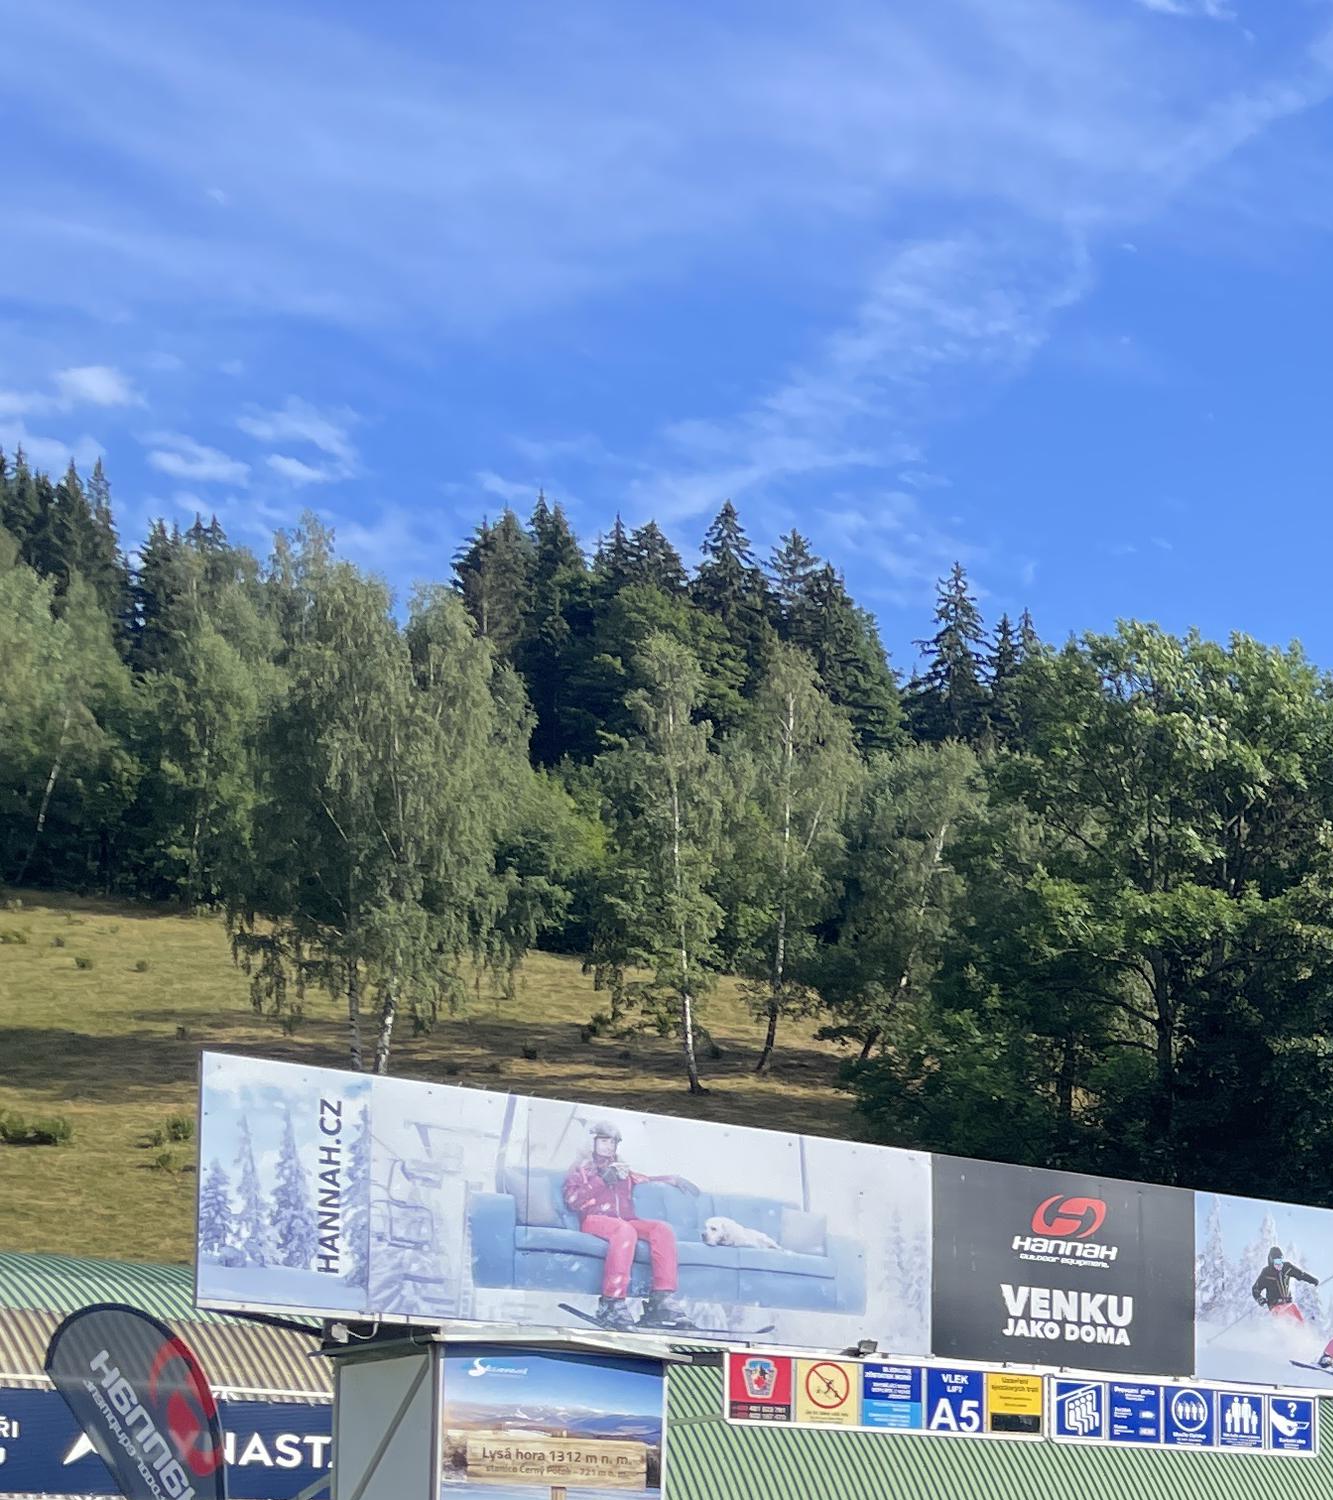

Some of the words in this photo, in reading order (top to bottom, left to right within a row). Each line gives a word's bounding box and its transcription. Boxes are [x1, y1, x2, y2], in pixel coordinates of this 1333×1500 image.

[317, 1098, 343, 1274] HANNAH.CZ
[1000, 1284, 1133, 1327] VENKU
[1002, 1318, 1060, 1339] JAKO
[1064, 1323, 1131, 1345] DOMA
[941, 1374, 969, 1385] VLEK
[946, 1385, 963, 1393] LIFT
[929, 1398, 980, 1432] A5
[482, 1447, 512, 1462] Lysá
[516, 1448, 545, 1461] hora
[549, 1450, 582, 1463] 1312
